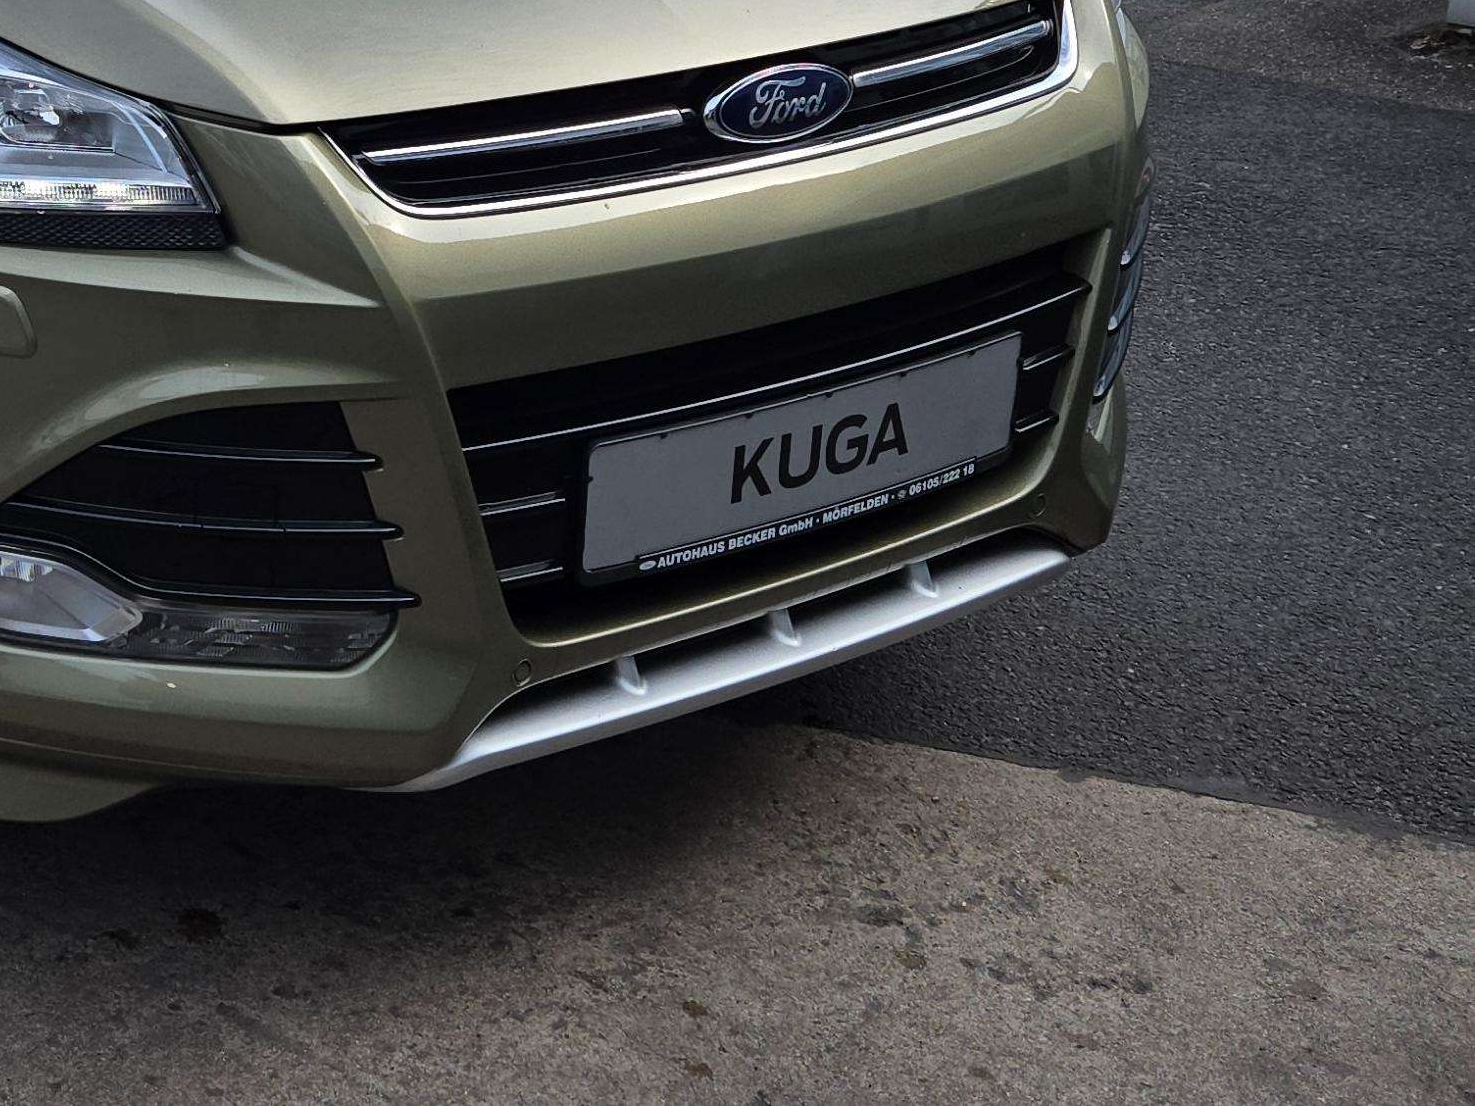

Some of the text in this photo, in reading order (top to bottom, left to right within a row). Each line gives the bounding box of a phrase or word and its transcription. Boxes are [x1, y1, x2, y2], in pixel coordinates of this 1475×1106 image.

[749, 76, 827, 129] Ford
[730, 402, 909, 504] KUGA
[657, 540, 726, 569] AUTOHAUS
[728, 526, 776, 551] BECKER
[778, 516, 814, 536] GmbH
[909, 473, 960, 496] 06105/222
